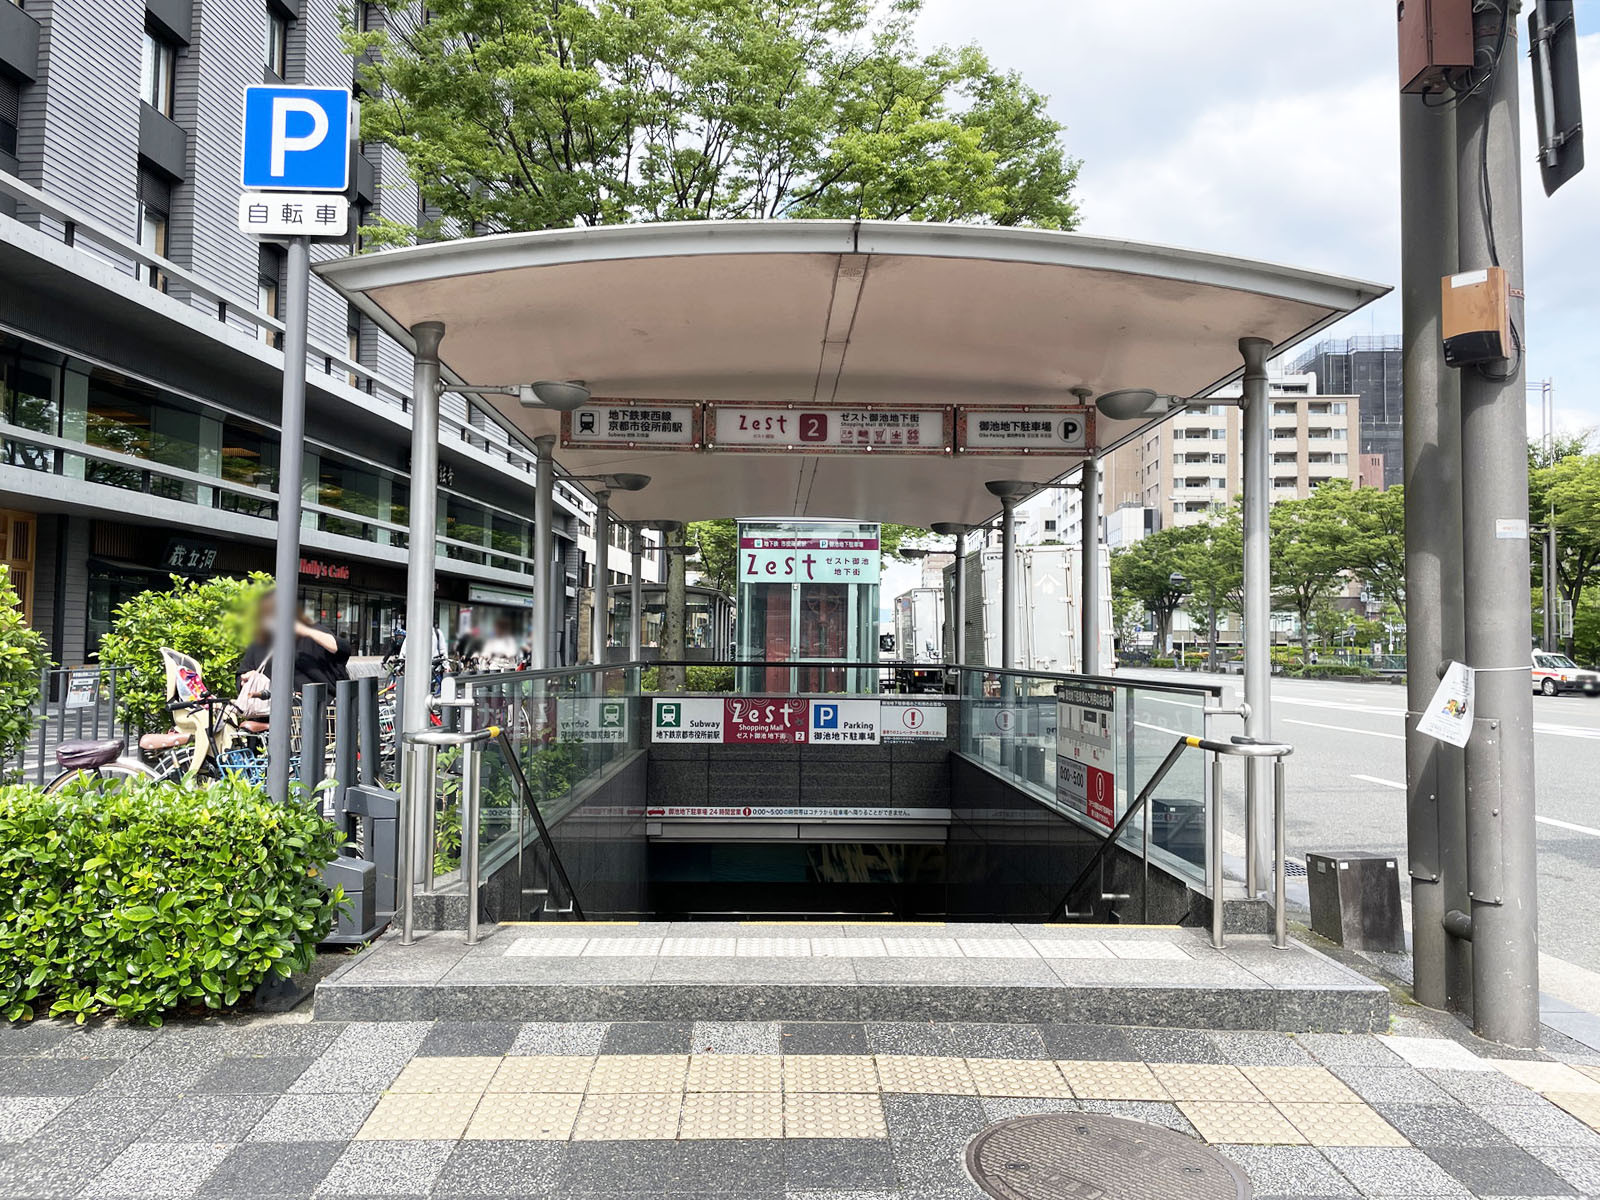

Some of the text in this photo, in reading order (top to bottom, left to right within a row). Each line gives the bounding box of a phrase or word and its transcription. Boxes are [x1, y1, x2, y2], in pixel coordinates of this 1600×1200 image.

[270, 97, 329, 177] P
[248, 203, 337, 227] 自転車
[608, 409, 672, 421] 地下鉄東西線
[840, 413, 920, 423] ゼスト御池地下街
[608, 421, 683, 433] 京都市役所前駅
[739, 414, 787, 434] Zest
[807, 418, 819, 437] 2
[979, 421, 1052, 432] 御池地下駐車場
[1063, 421, 1078, 440] P
[825, 557, 869, 565] ゼスト御池
[746, 553, 817, 581] Zest
[834, 568, 860, 576] 地下街
[731, 703, 794, 728] Zest
[819, 707, 834, 726] P
[689, 720, 721, 729] Subway
[738, 724, 769, 732] Shopping
[843, 722, 874, 731] Parking
[656, 730, 721, 740] 地下鉄京都市役所前駅
[736, 732, 786, 740] ゼスト御池地下街
[797, 732, 803, 740] 2
[813, 732, 876, 741] 御池地下駐車場
